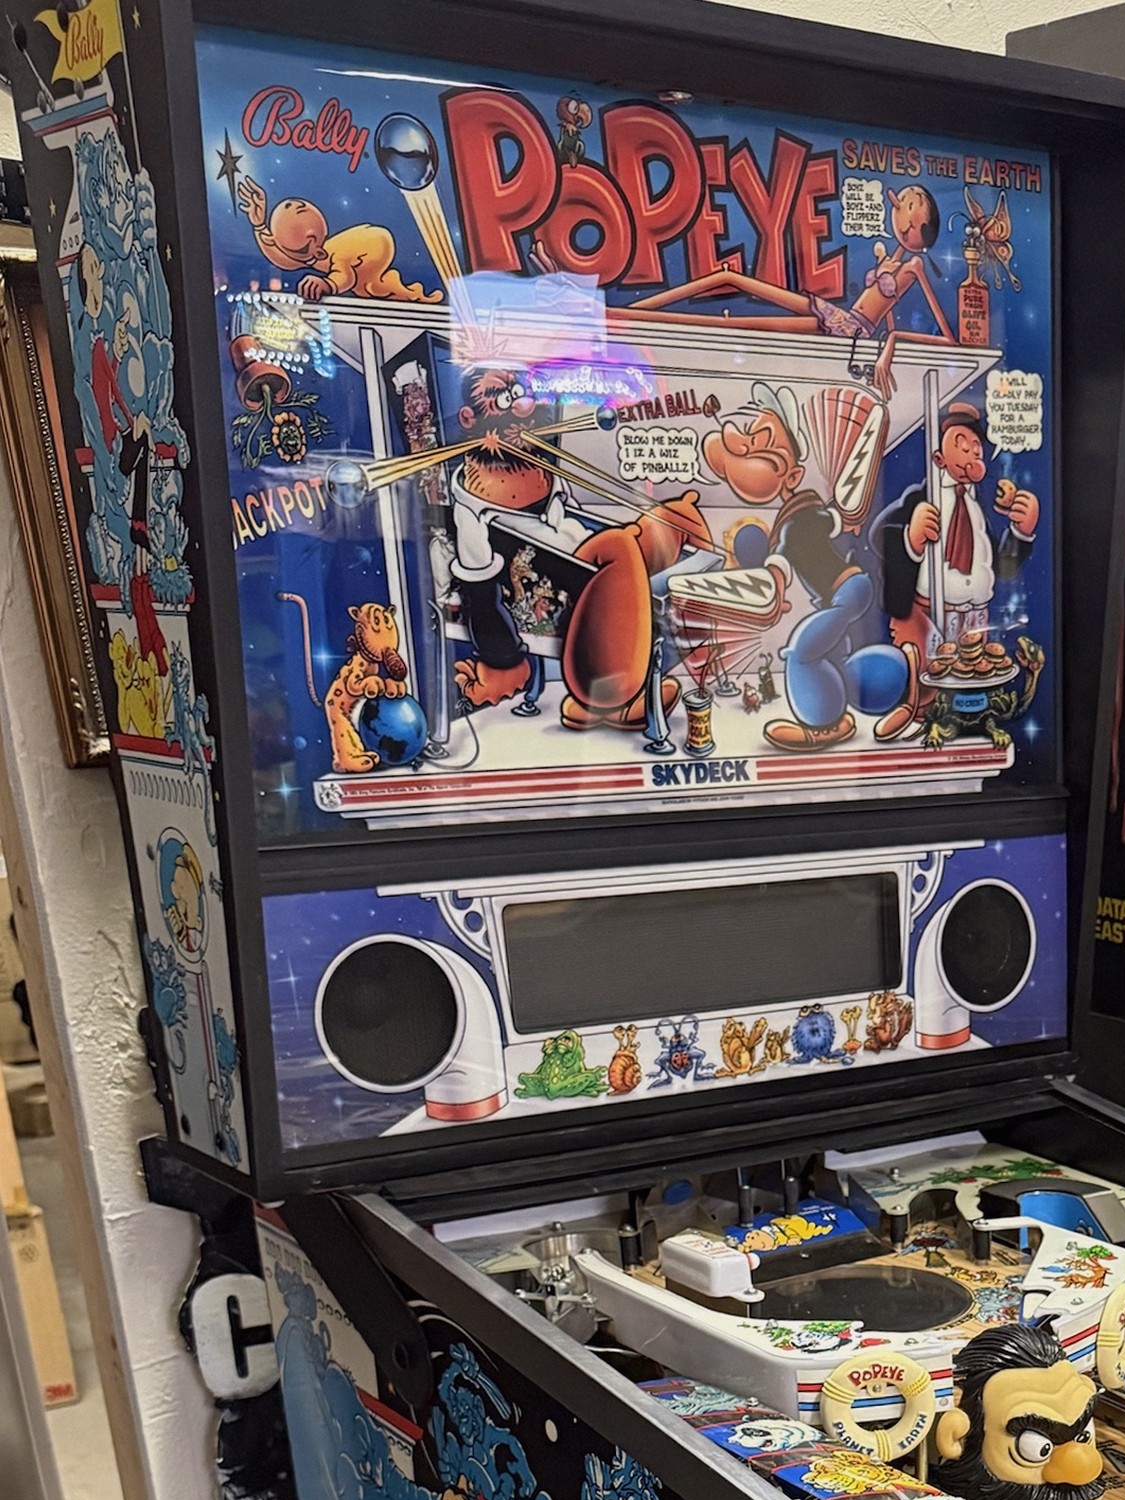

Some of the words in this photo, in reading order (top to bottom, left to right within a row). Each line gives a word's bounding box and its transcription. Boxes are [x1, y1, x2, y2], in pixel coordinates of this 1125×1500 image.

[64, 8, 104, 66] Bally
[241, 86, 370, 172] Bally
[842, 138, 921, 178] SAVES
[924, 155, 958, 178] THE
[963, 155, 1043, 193] EARTH
[439, 84, 847, 300] POPEYE
[617, 397, 665, 423] EXTRA
[664, 389, 702, 417] BALL
[989, 402, 1005, 412] YOU
[1006, 402, 1039, 413] TUESDAY
[1000, 414, 1015, 422] FOR
[1018, 414, 1025, 422] A
[623, 435, 649, 445] BLOW
[652, 436, 665, 445] ME
[668, 437, 694, 446] DOWN
[634, 448, 645, 458] IZ
[648, 448, 656, 458] A
[660, 449, 679, 458] WIZ
[623, 463, 637, 472] OF
[651, 760, 750, 787] SKYDECK
[848, 1363, 905, 1387] POPEYE
[832, 1421, 875, 1456] PLANET
[898, 1414, 928, 1450] EARTH
